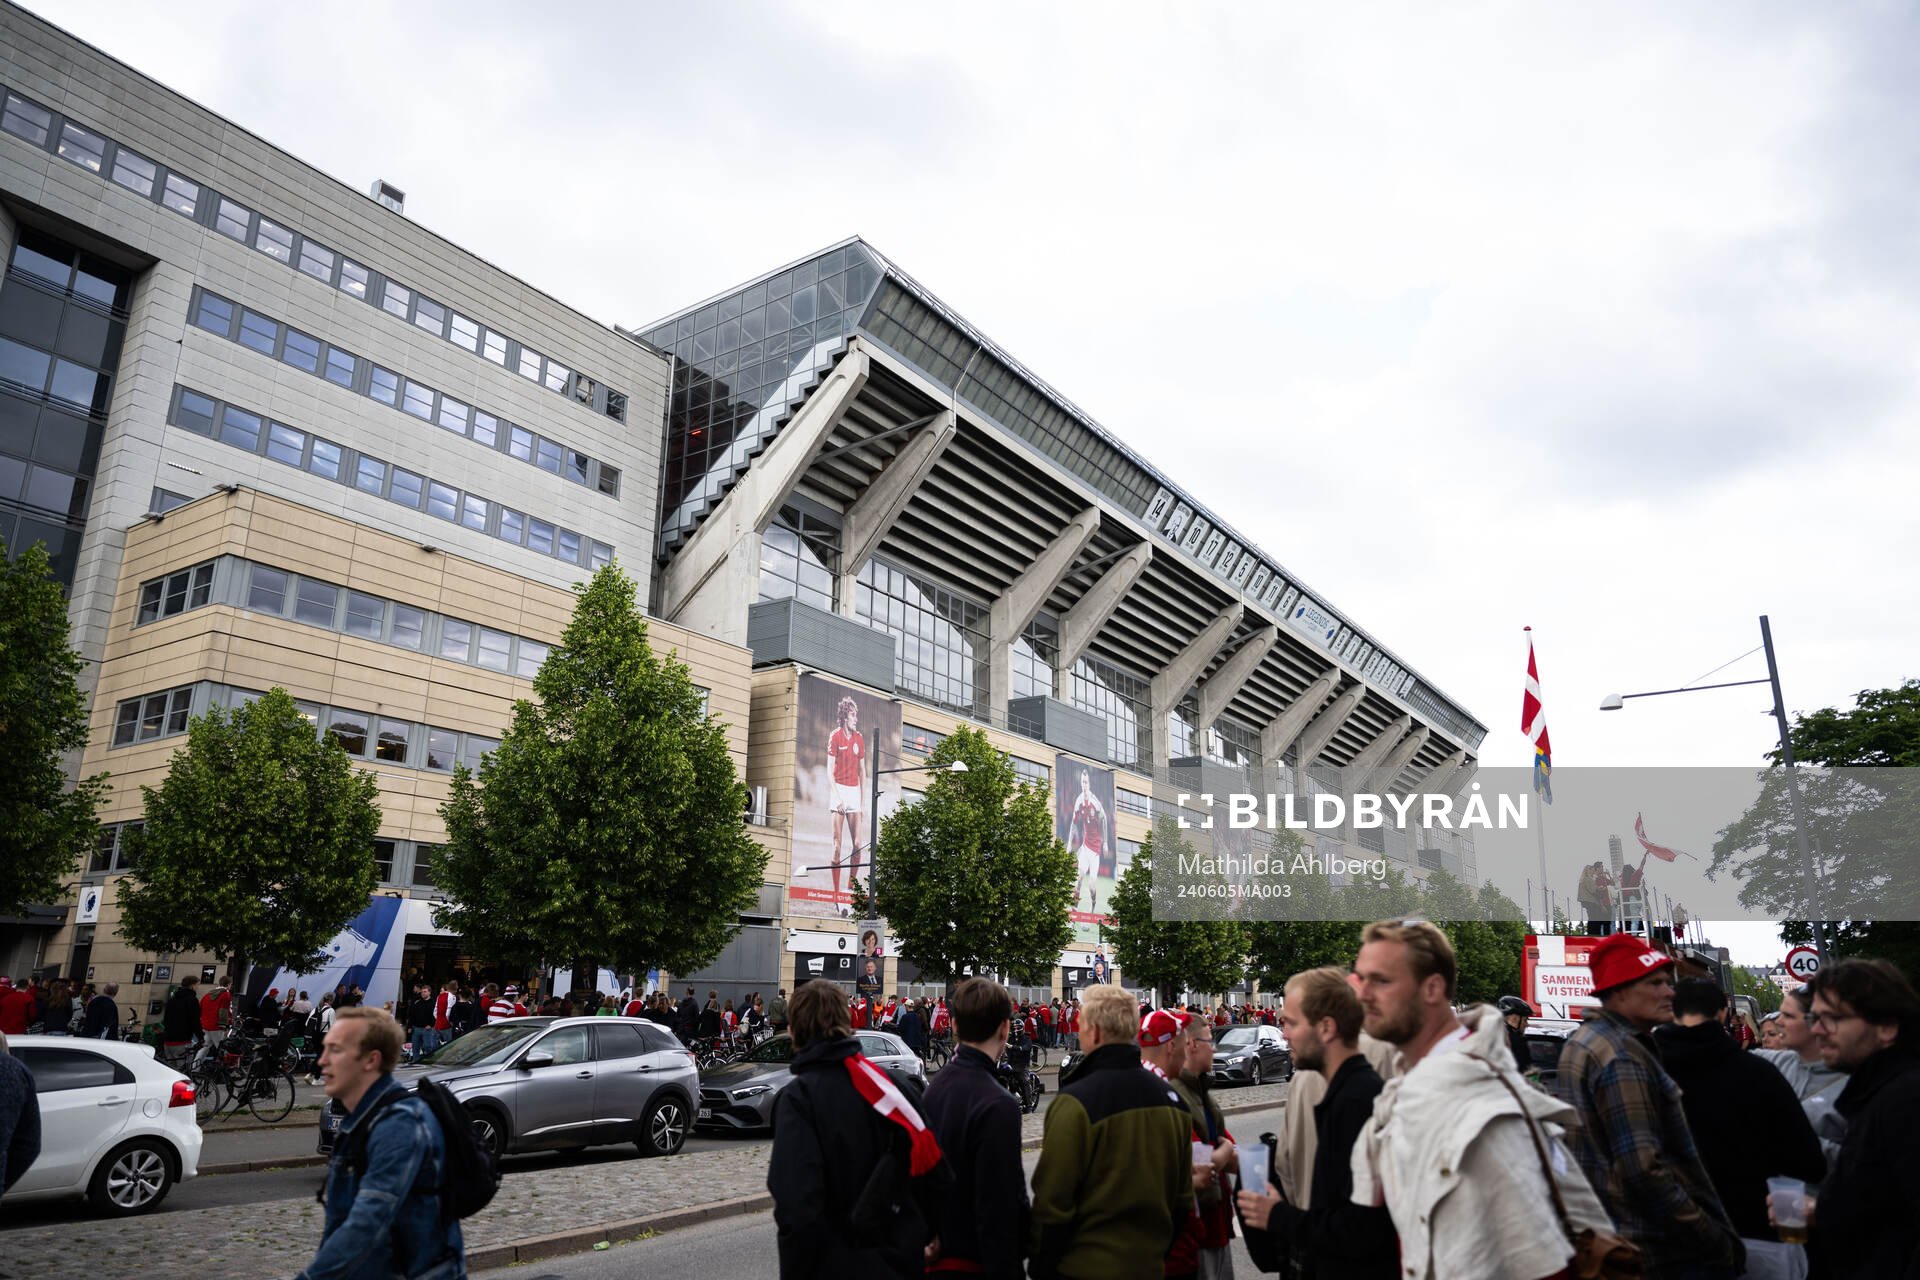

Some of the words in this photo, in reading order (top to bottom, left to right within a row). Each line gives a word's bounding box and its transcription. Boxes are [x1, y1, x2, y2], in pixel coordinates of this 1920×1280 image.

[1151, 498, 1166, 518] 14
[1188, 527, 1201, 545] 10
[1205, 539, 1219, 556] 17
[1221, 551, 1234, 568] 12
[1238, 562, 1248, 578] 5
[1305, 607, 1330, 629] LEGENDS
[1793, 957, 1819, 972] 40
[1541, 974, 1590, 985] SAMMEN
[1546, 986, 1558, 996] VI
[1560, 987, 1592, 997] STEM
